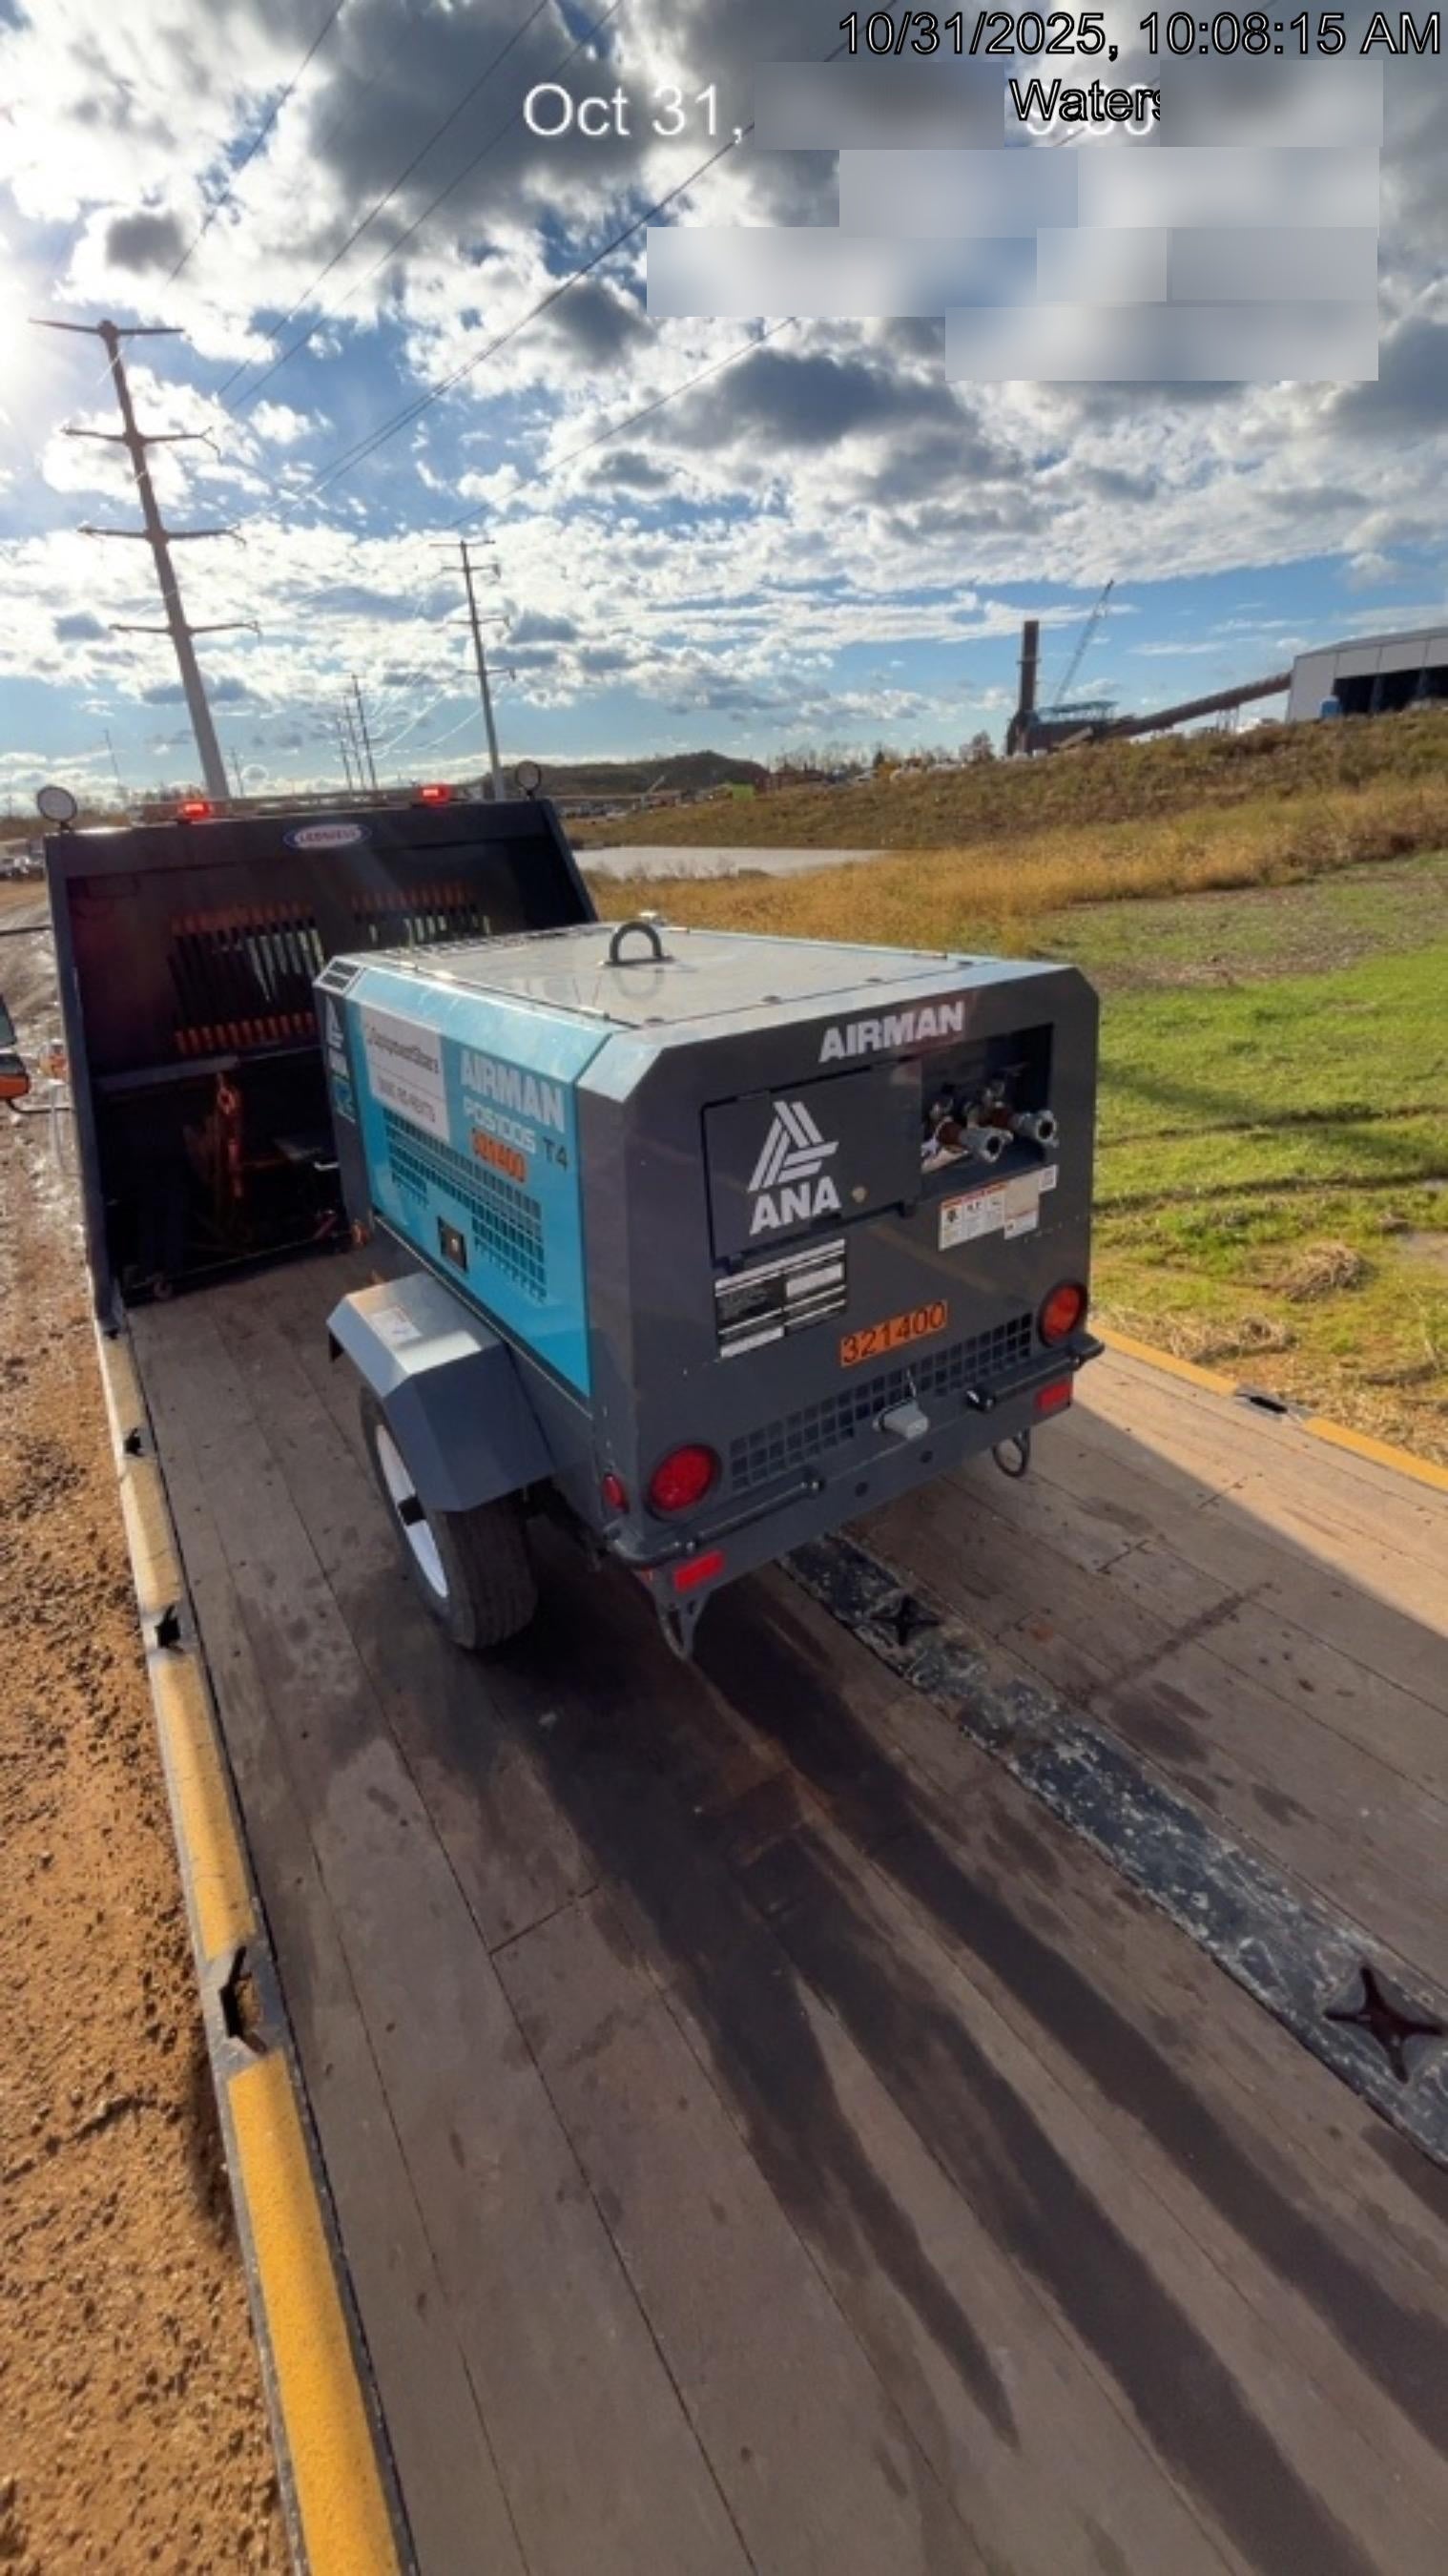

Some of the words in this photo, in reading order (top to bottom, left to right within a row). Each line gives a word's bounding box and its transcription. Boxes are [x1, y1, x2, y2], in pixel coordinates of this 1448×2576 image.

[817, 1000, 965, 1064] AIRMAN
[460, 1048, 566, 1134] AIRMAN
[749, 1175, 842, 1236] ANA
[843, 1301, 945, 1364] 321400
